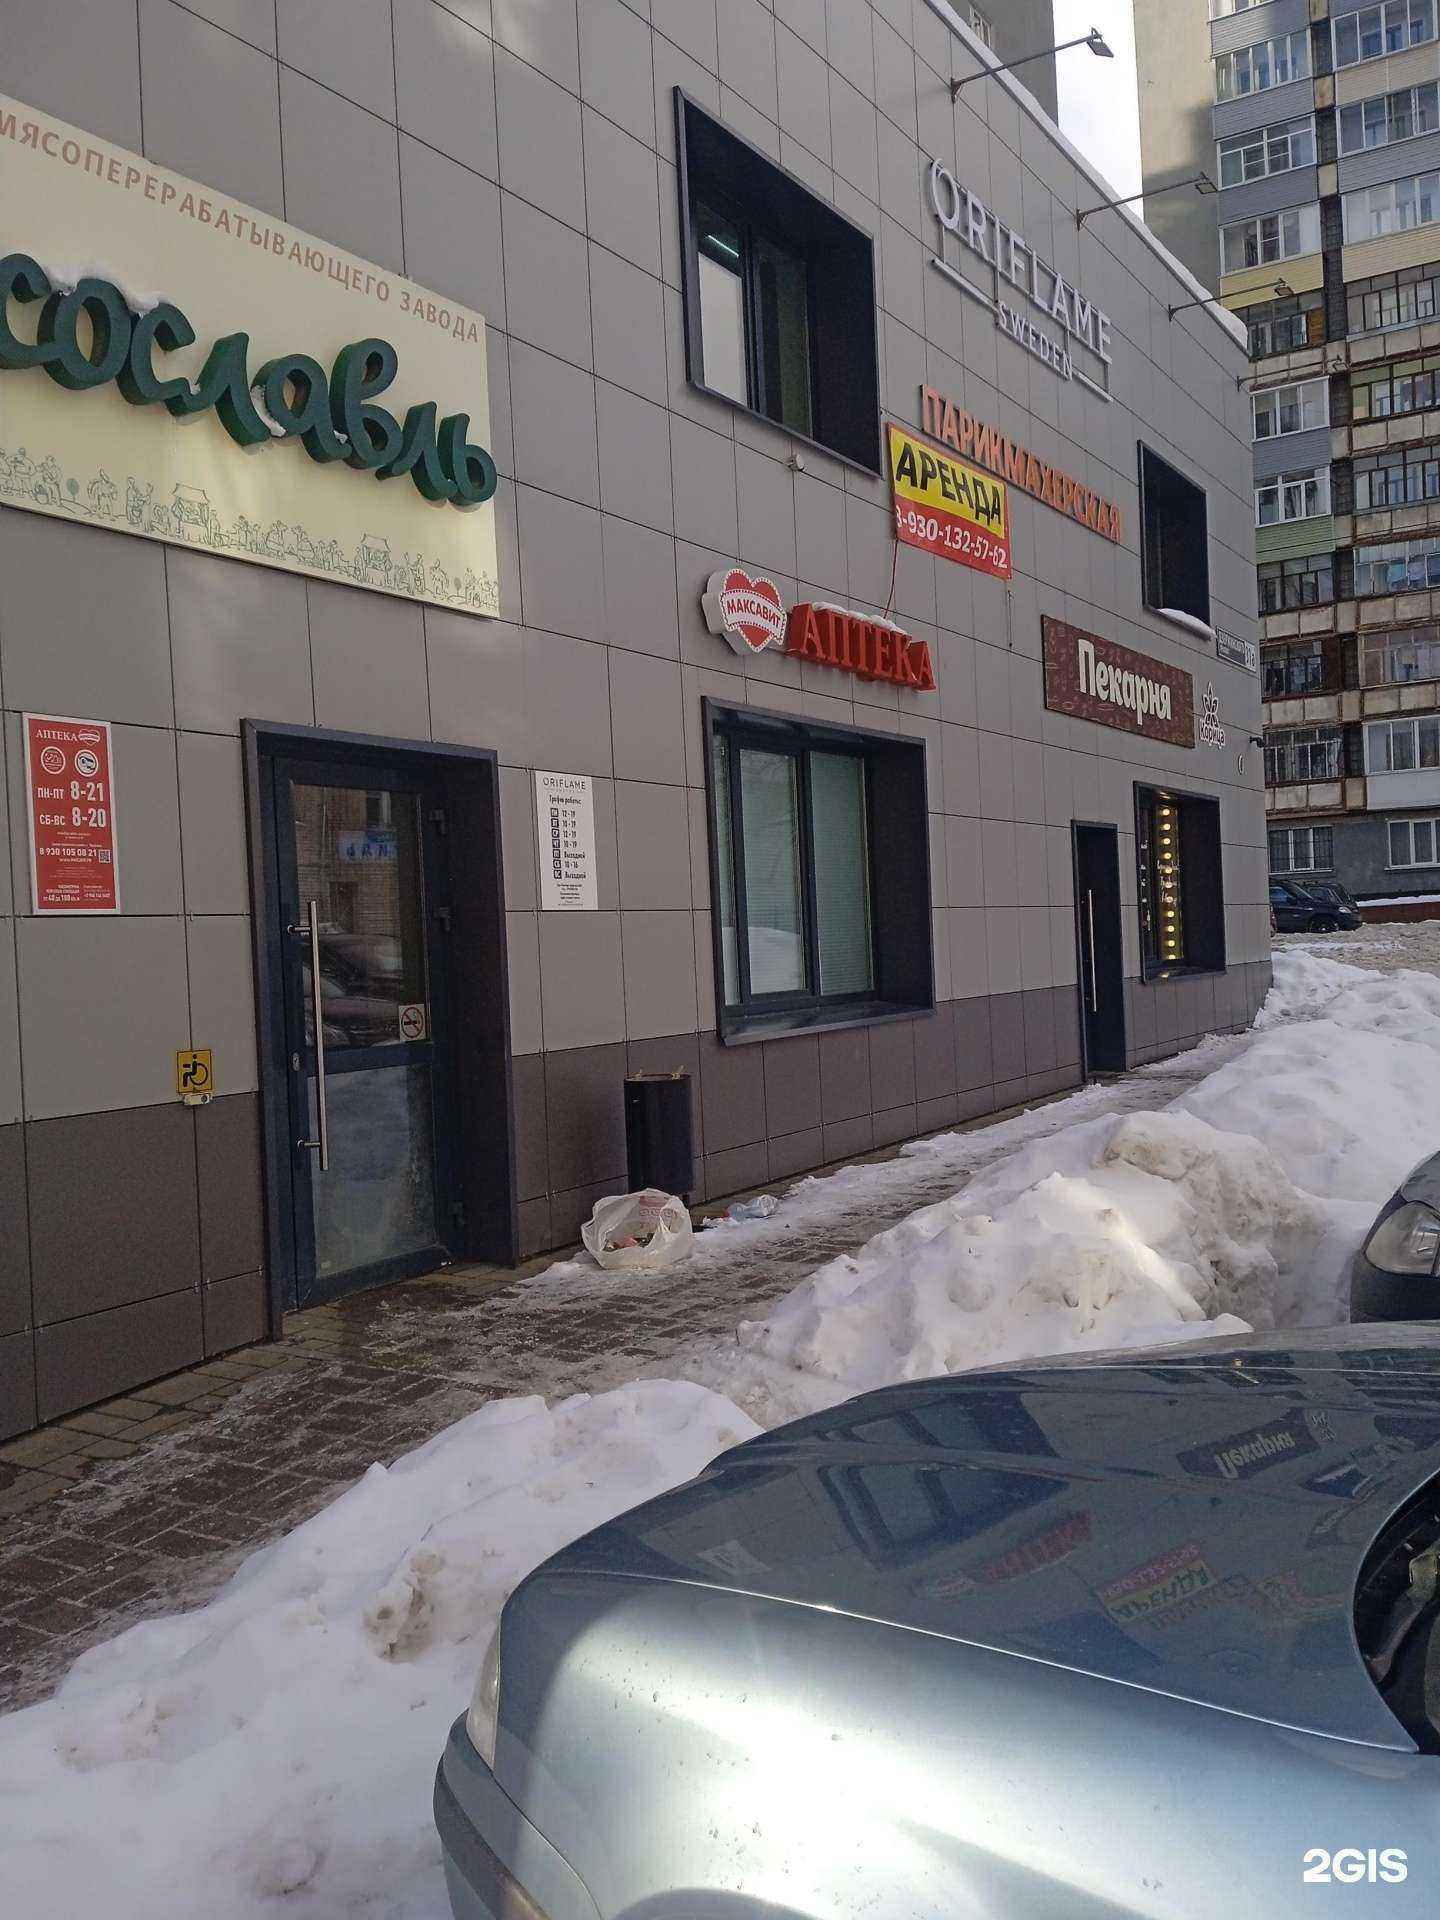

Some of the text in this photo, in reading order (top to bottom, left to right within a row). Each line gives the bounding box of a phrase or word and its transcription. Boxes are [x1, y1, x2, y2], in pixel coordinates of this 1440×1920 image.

[930, 158, 1113, 366] ORIFLAME
[400, 288, 479, 343] ЗАВОДА
[1000, 302, 1074, 381] SWEDEN
[896, 442, 1002, 526] АРЕНДА
[920, 384, 1121, 543] ПАРИКМАХЕРСКАЯ
[726, 600, 781, 627] МАКСАВИТ
[798, 603, 937, 692] АПТЕКА
[1077, 638, 1172, 725] Пекарня
[35, 729, 78, 742] АПТЕКА
[37, 780, 104, 802] ПН-ПТ 8-21
[543, 777, 586, 790] ORIFLAME
[39, 807, 107, 828] СБ-ВС 8-20
[46, 847, 60, 856] 930
[88, 849, 97, 857] 21
